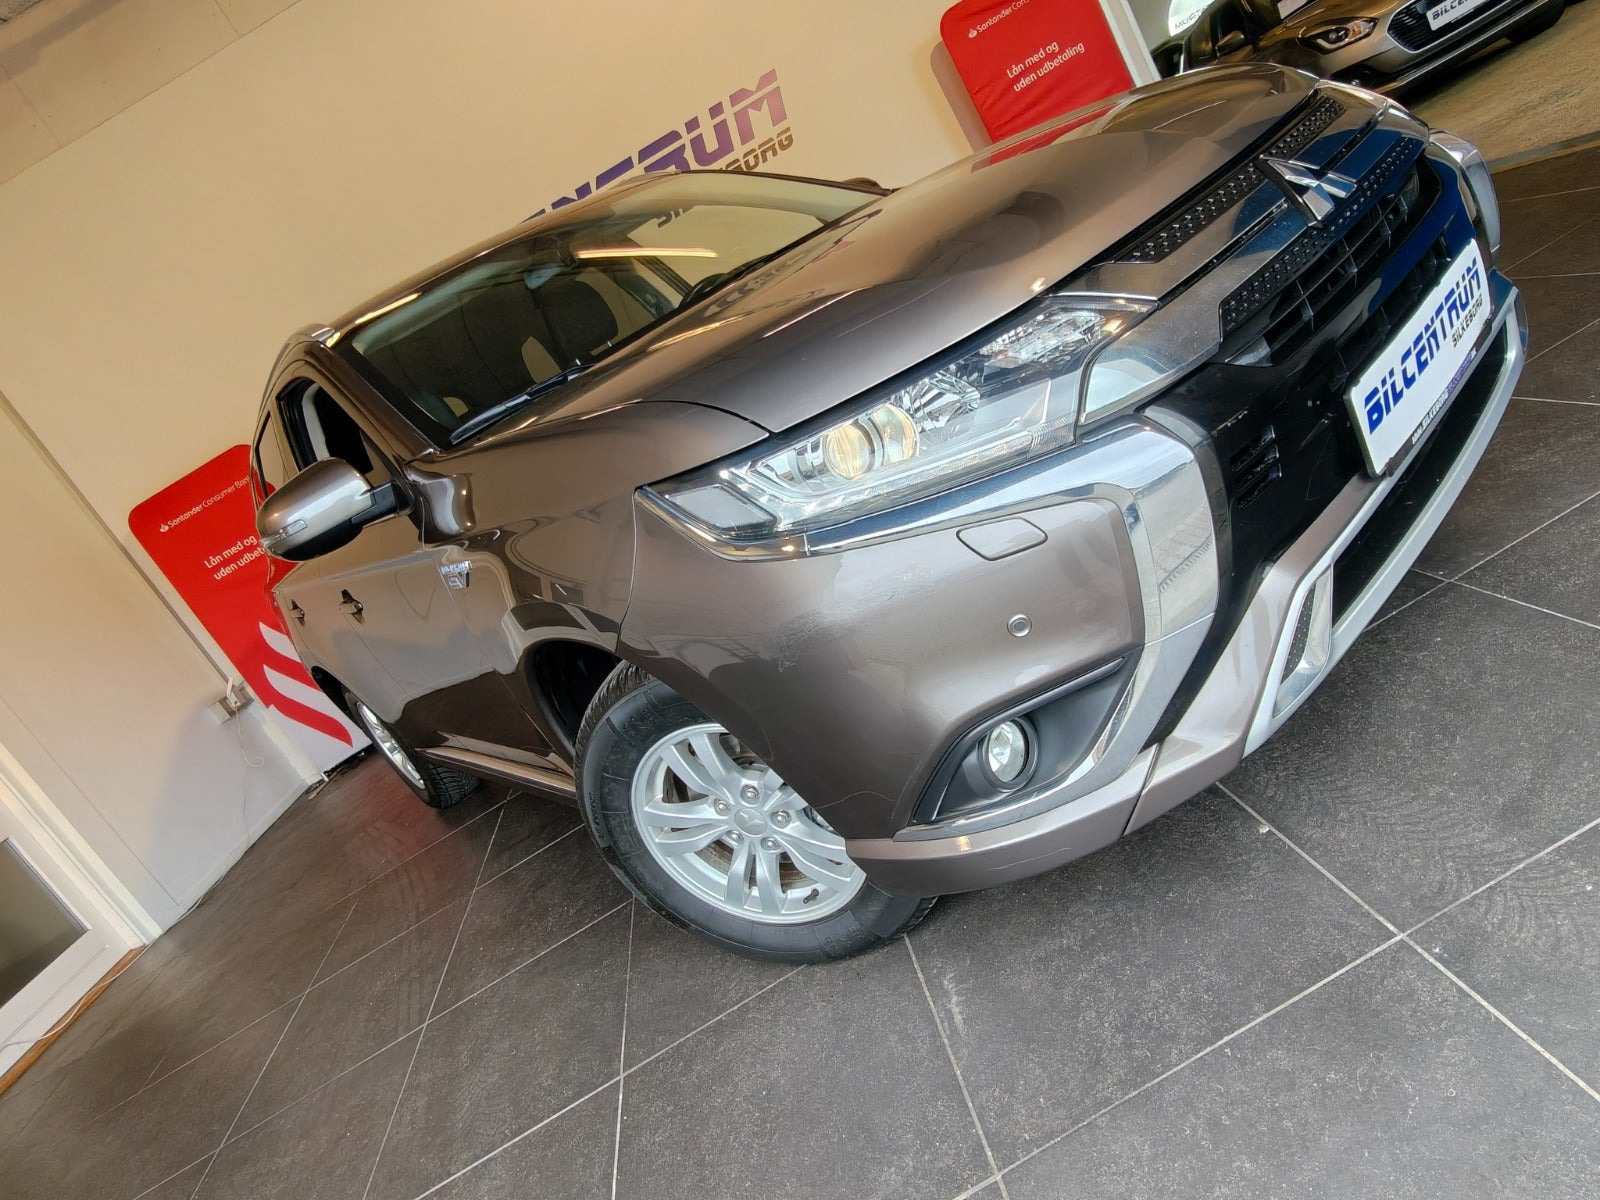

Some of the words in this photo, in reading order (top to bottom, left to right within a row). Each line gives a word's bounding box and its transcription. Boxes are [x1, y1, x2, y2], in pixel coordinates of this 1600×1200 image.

[976, 6, 1013, 32] Santander
[1006, 61, 1025, 79] Lån
[1025, 48, 1046, 69] med
[1045, 41, 1060, 55] og
[1013, 72, 1038, 92] uden
[1037, 42, 1086, 77] udbetaling
[1452, 294, 1484, 348] SILKEBORG
[1363, 256, 1483, 436] BILCENTRUM
[167, 504, 203, 528] Santander
[202, 485, 236, 508] Consumer
[204, 554, 224, 569] Lån
[222, 541, 245, 560] med
[243, 535, 258, 547] og
[213, 563, 239, 580] uden
